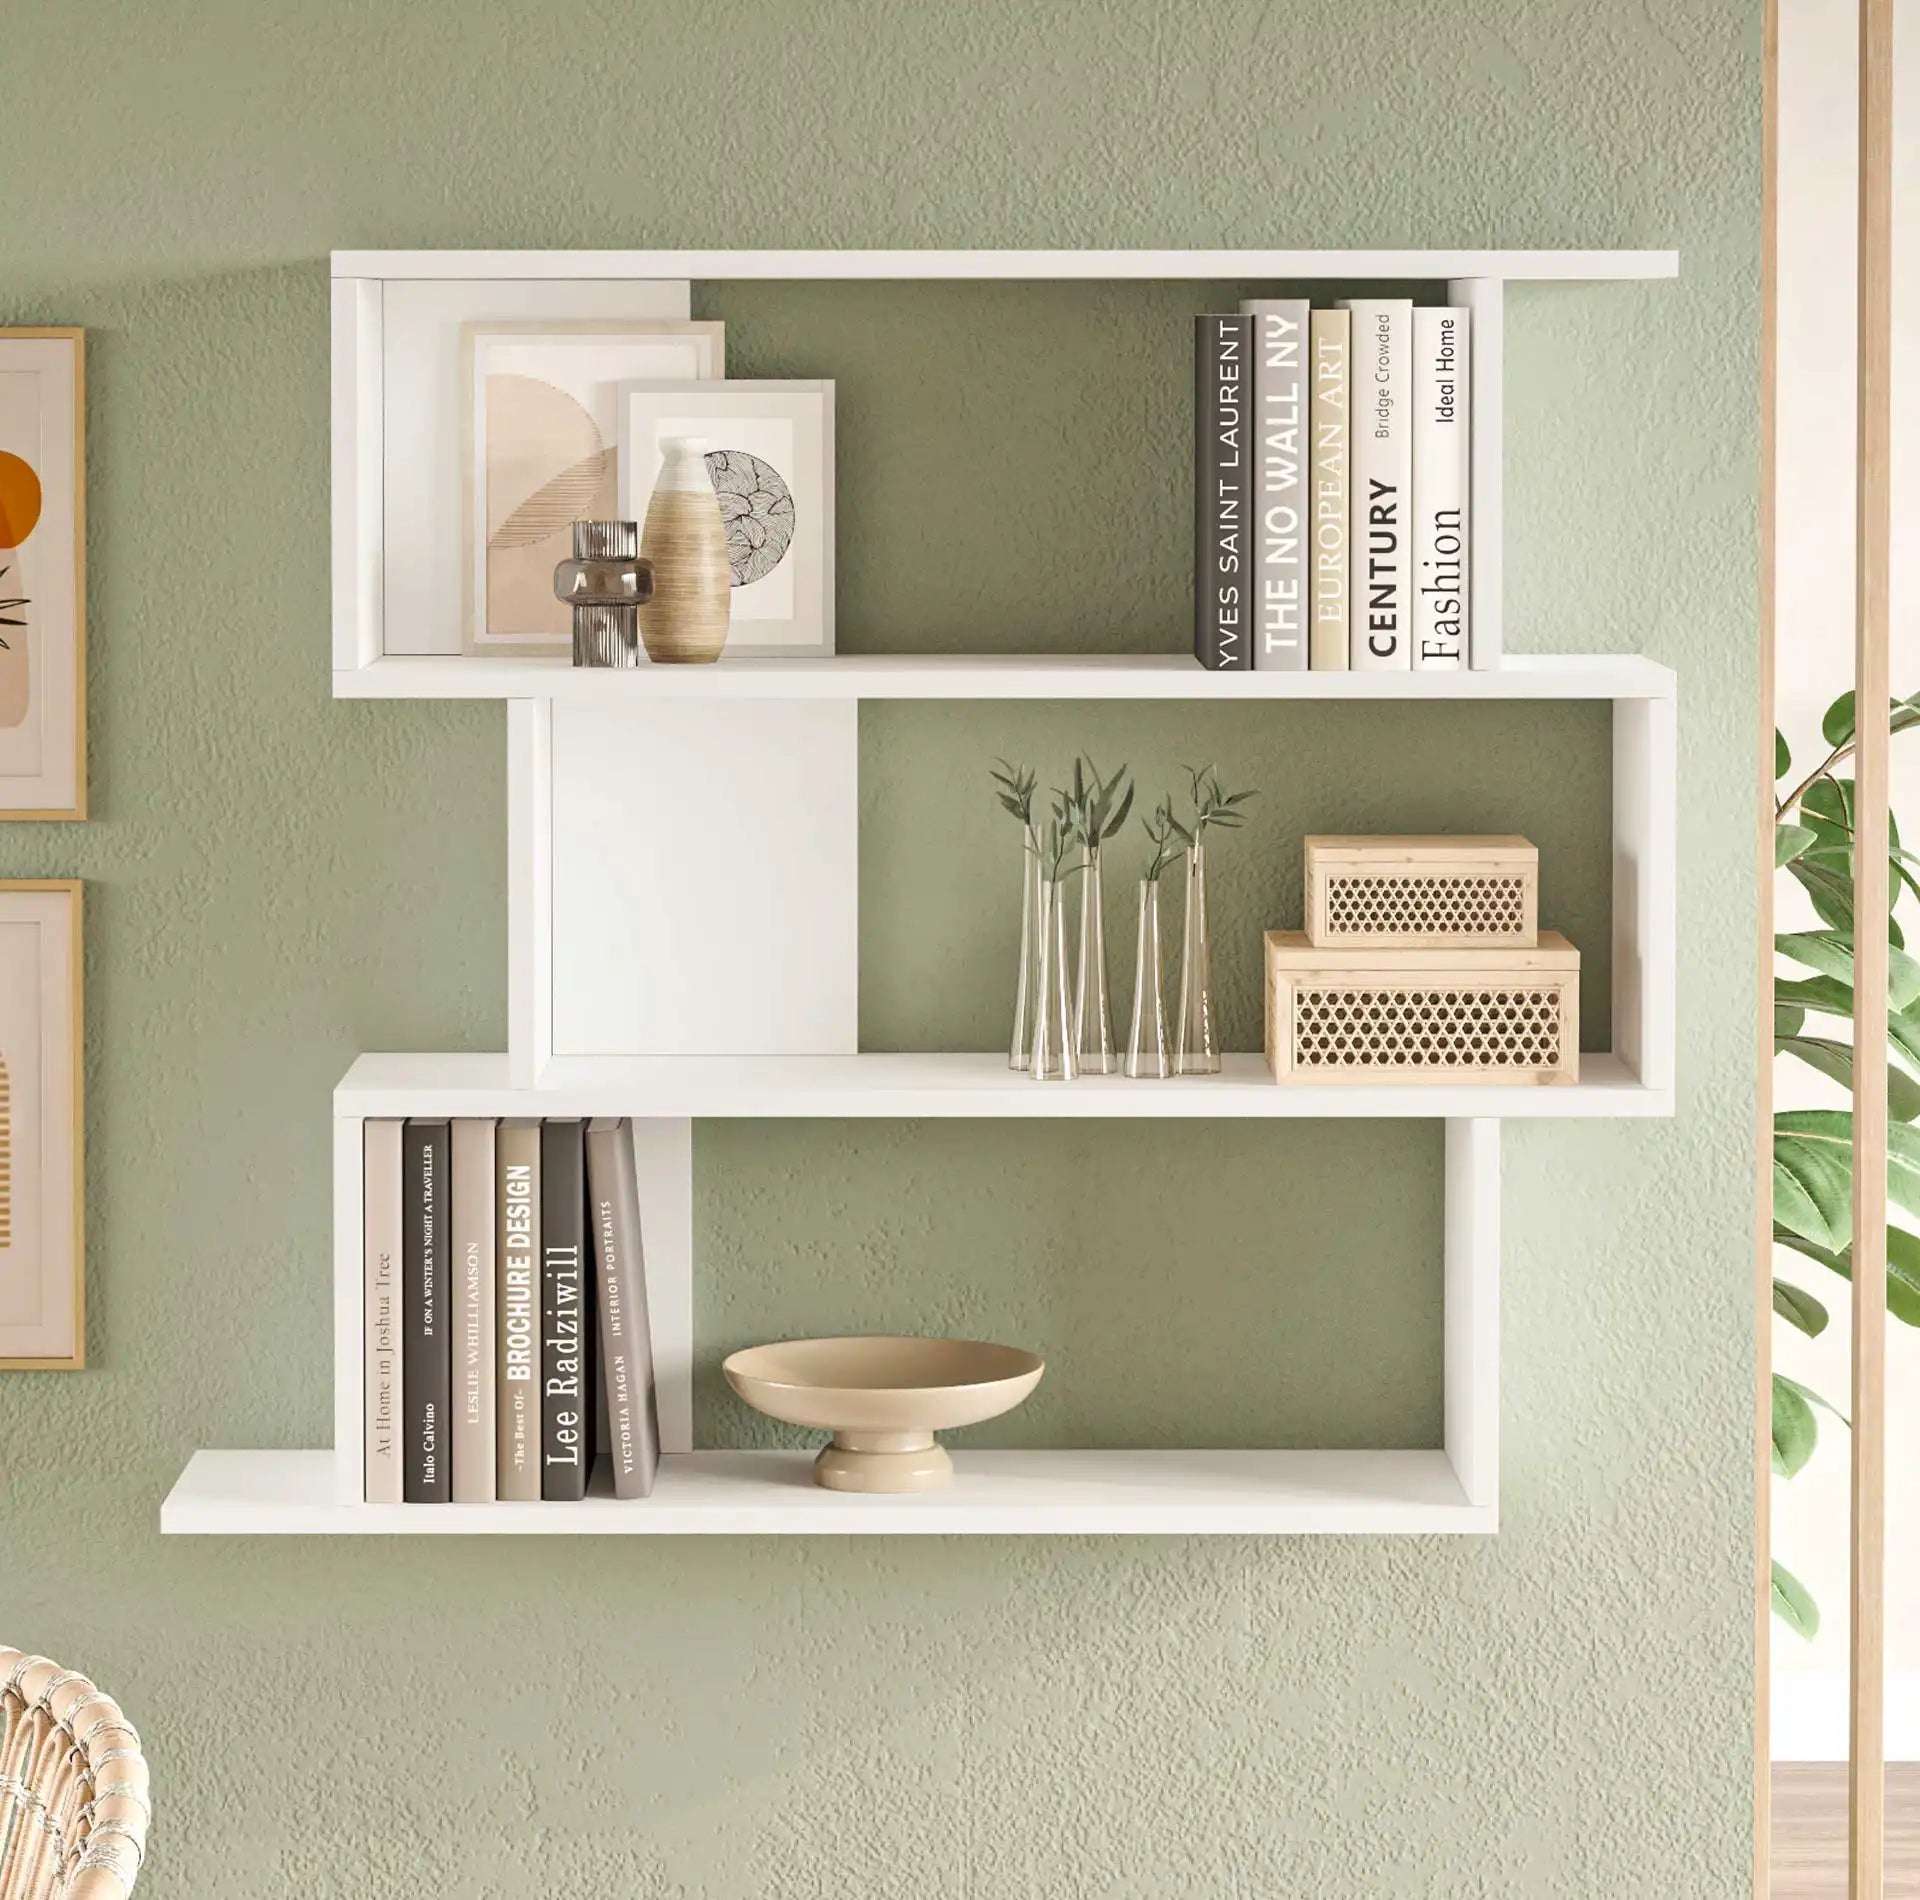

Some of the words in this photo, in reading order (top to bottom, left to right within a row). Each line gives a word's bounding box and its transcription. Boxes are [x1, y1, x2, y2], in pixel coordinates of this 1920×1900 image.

[1266, 314, 1298, 367] NY
[1375, 314, 1390, 383] Crowded
[1435, 319, 1454, 371] Home
[1219, 320, 1239, 467] LAURENT
[1318, 337, 1343, 408] ART
[1375, 389, 1393, 438] Bridge
[1435, 379, 1454, 423] Ideal
[1266, 383, 1298, 491] WALL
[1219, 480, 1239, 573] SAINT
[1265, 506, 1298, 562] NO
[1318, 421, 1343, 623] EUROPEAN
[1368, 478, 1397, 657] CENTURY
[1421, 508, 1460, 661] Fashion
[1219, 587, 1239, 667] YVES
[1266, 579, 1298, 653] THE
[424, 1145, 432, 1203] TRAVELLER
[424, 1204, 432, 1213] A
[424, 1214, 433, 1246] NIGHT
[507, 1165, 530, 1248] DESIGN
[601, 1200, 615, 1270] PORTRAITS
[376, 1254, 390, 1290] Tree
[376, 1296, 394, 1355] Joshua
[424, 1298, 432, 1307] A
[424, 1309, 432, 1324] ON
[507, 1256, 531, 1380] BROCHURE
[546, 1245, 578, 1396] Radziwill
[608, 1276, 622, 1336] INTERIOR
[424, 1326, 432, 1336] IF
[376, 1360, 390, 1375] in
[615, 1355, 627, 1401] HAGAN
[376, 1382, 390, 1430] Home
[467, 1370, 479, 1423] LESLIE
[376, 1437, 390, 1457] At
[423, 1403, 435, 1451] Calvino
[547, 1411, 578, 1466] Lee
[620, 1408, 634, 1473] VICTORIA
[424, 1455, 435, 1483] Italo
